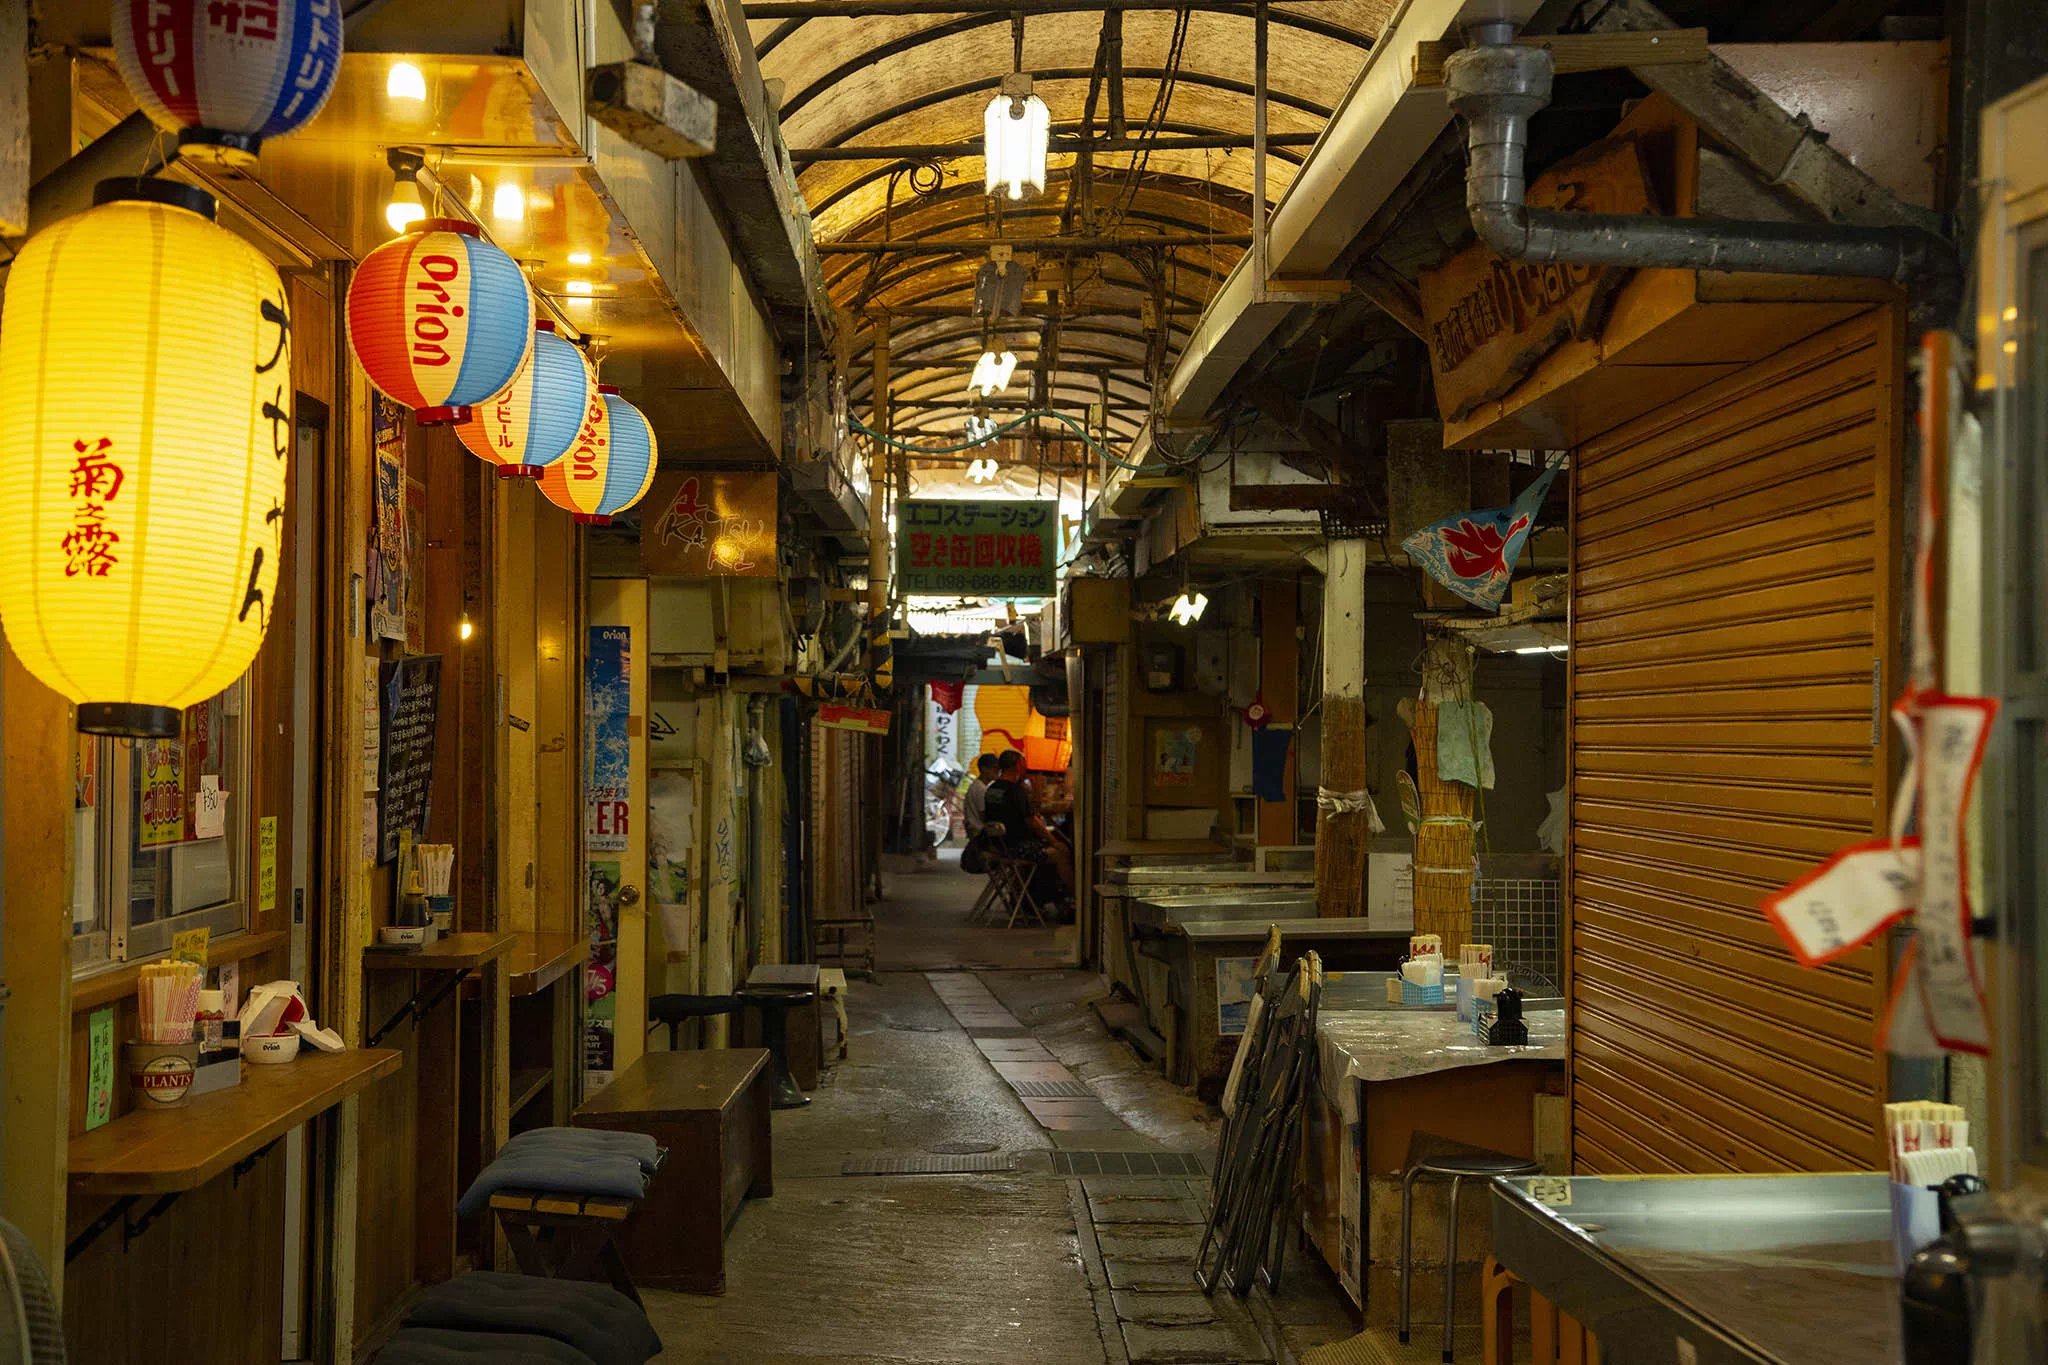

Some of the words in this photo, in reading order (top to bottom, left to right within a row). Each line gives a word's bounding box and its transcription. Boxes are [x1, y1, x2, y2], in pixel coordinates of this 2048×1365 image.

[412, 254, 464, 367] Orion
[61, 437, 125, 577] 菊之露
[905, 502, 1047, 528] エコステーション
[910, 531, 1043, 569] 空き缶回収機
[602, 629, 627, 641] Orion
[935, 705, 952, 755] わくわく
[588, 800, 629, 834] ER
[143, 1073, 192, 1088] PLANTS
[1534, 1184, 1568, 1202] E-3
